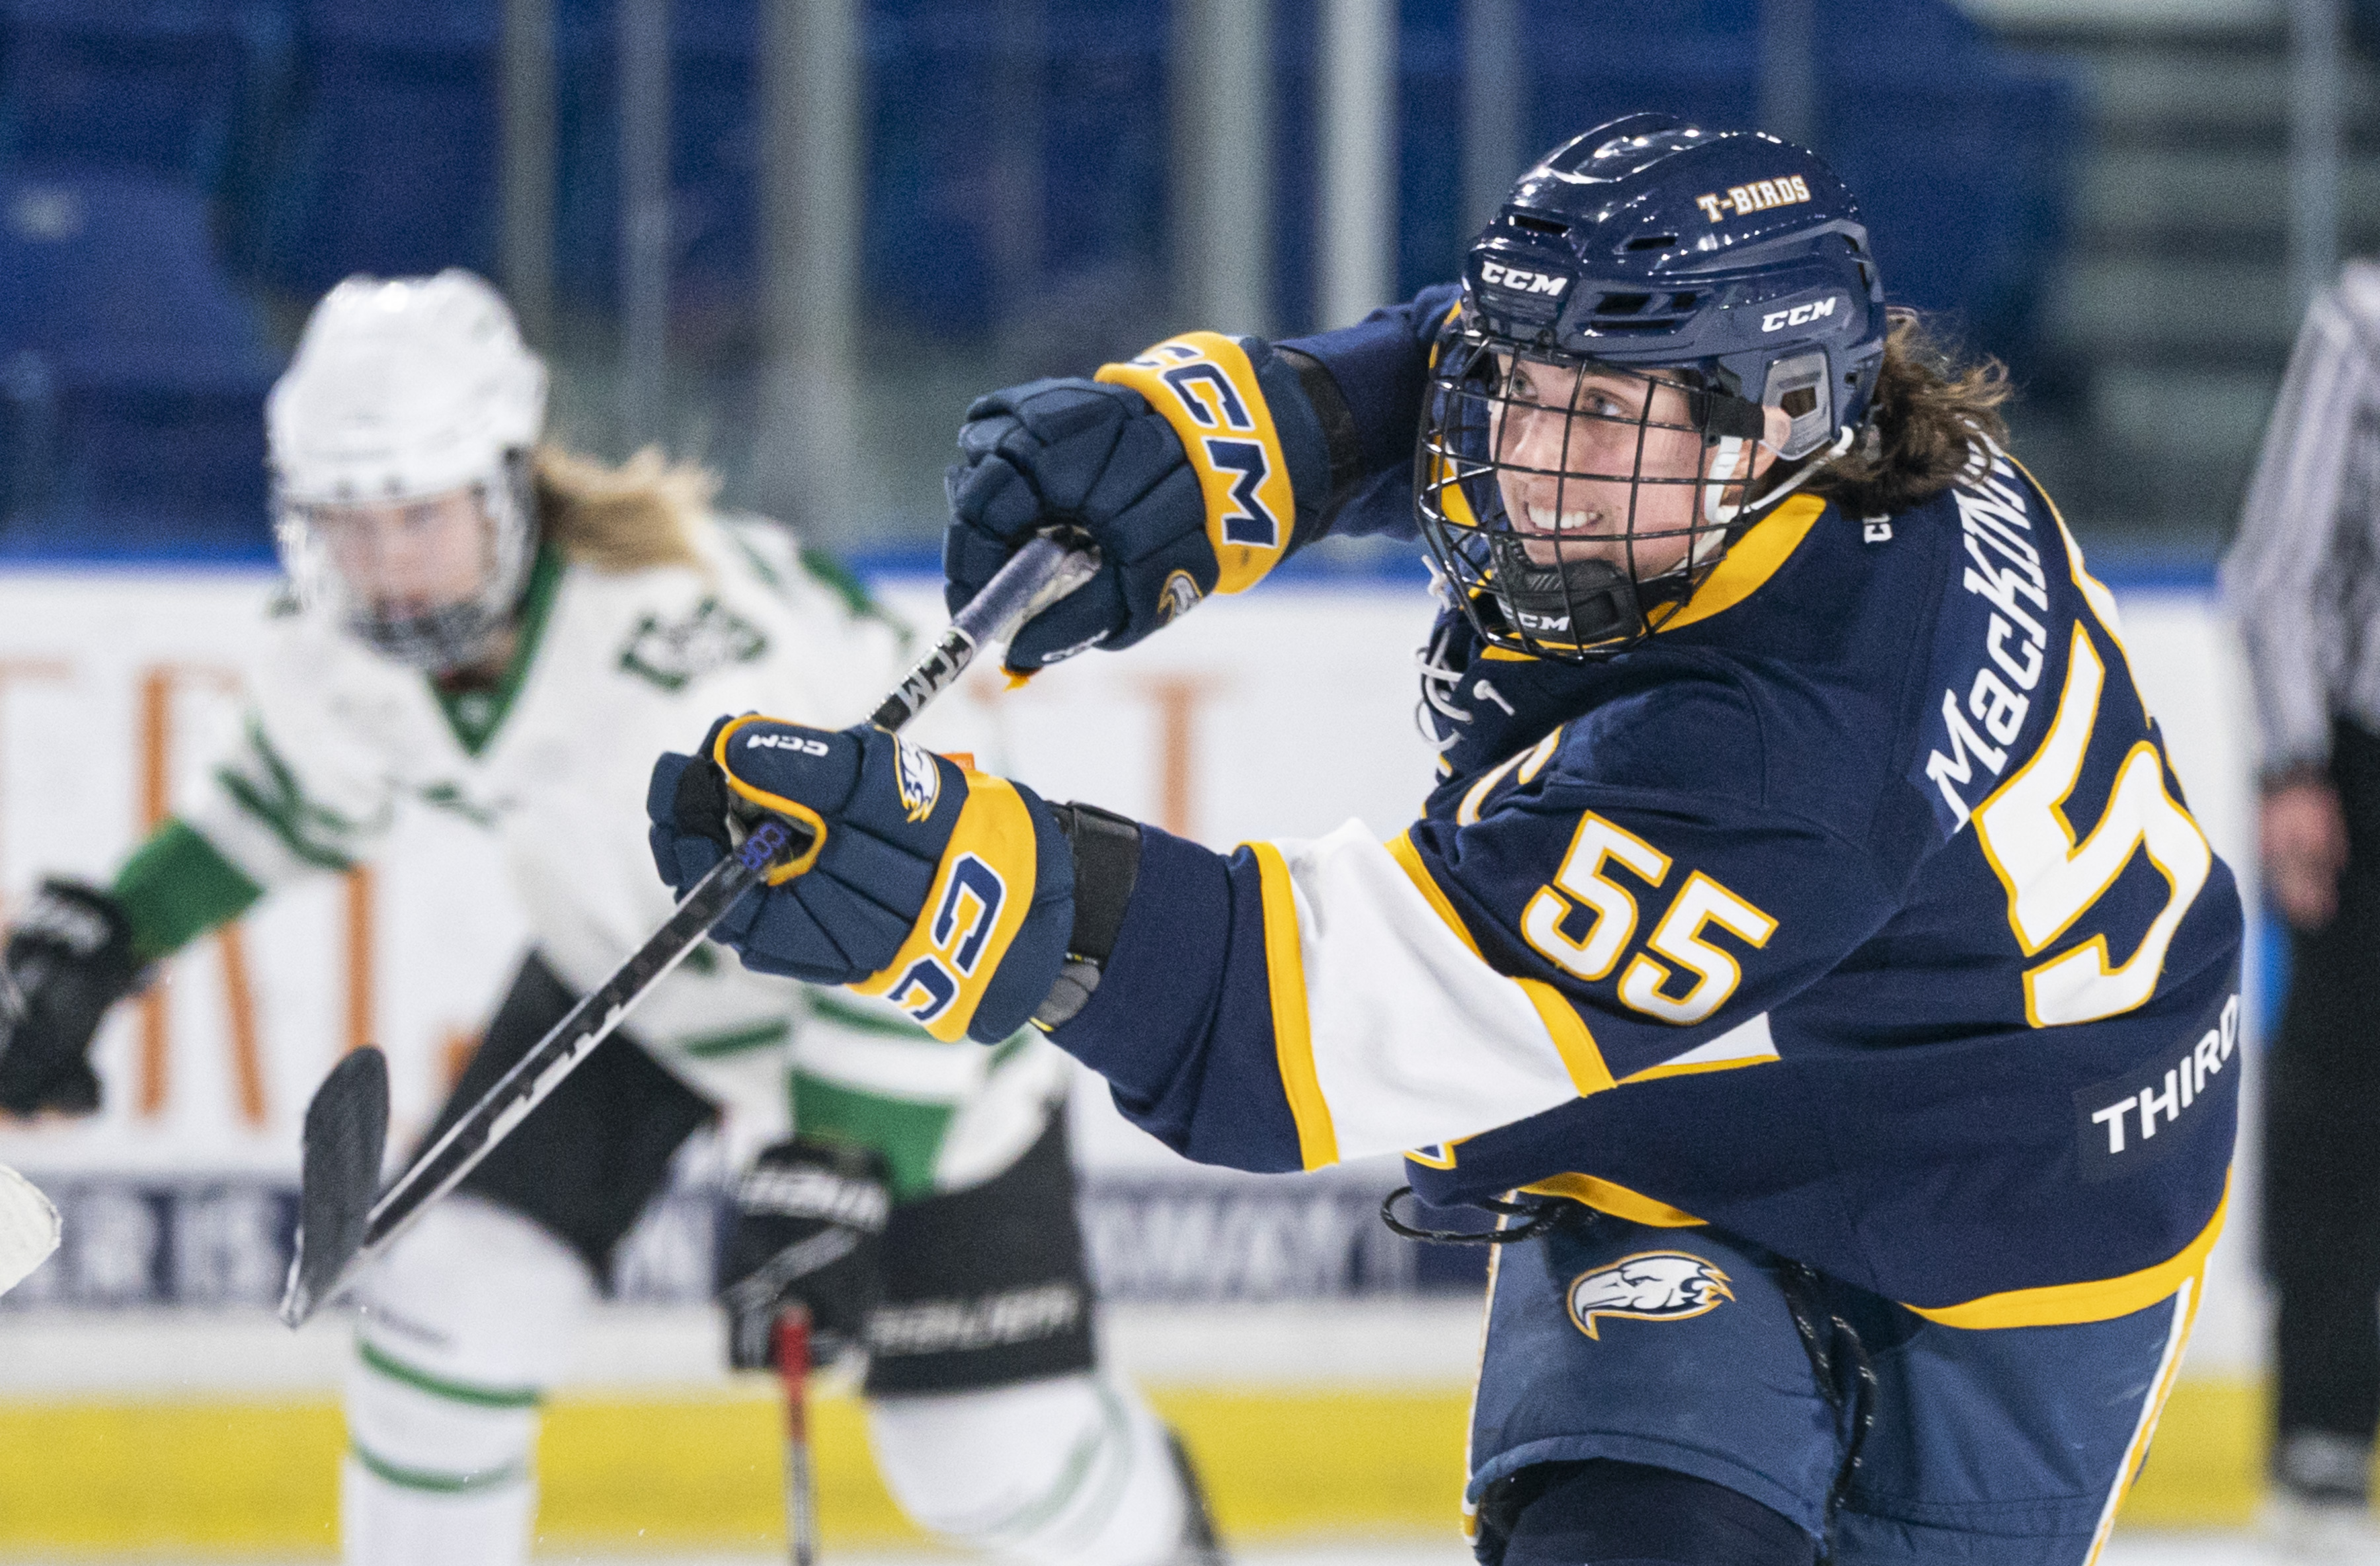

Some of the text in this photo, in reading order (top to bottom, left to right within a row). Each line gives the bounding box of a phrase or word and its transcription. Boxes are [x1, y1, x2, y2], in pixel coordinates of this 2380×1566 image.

[1696, 175, 1811, 222] T-BIRDS
[1481, 261, 1567, 296] CCM
[1761, 297, 1837, 333] CCM
[747, 734, 829, 757] CCM
[1521, 809, 1780, 1026] 55
[2092, 993, 2239, 1154] THIRD
